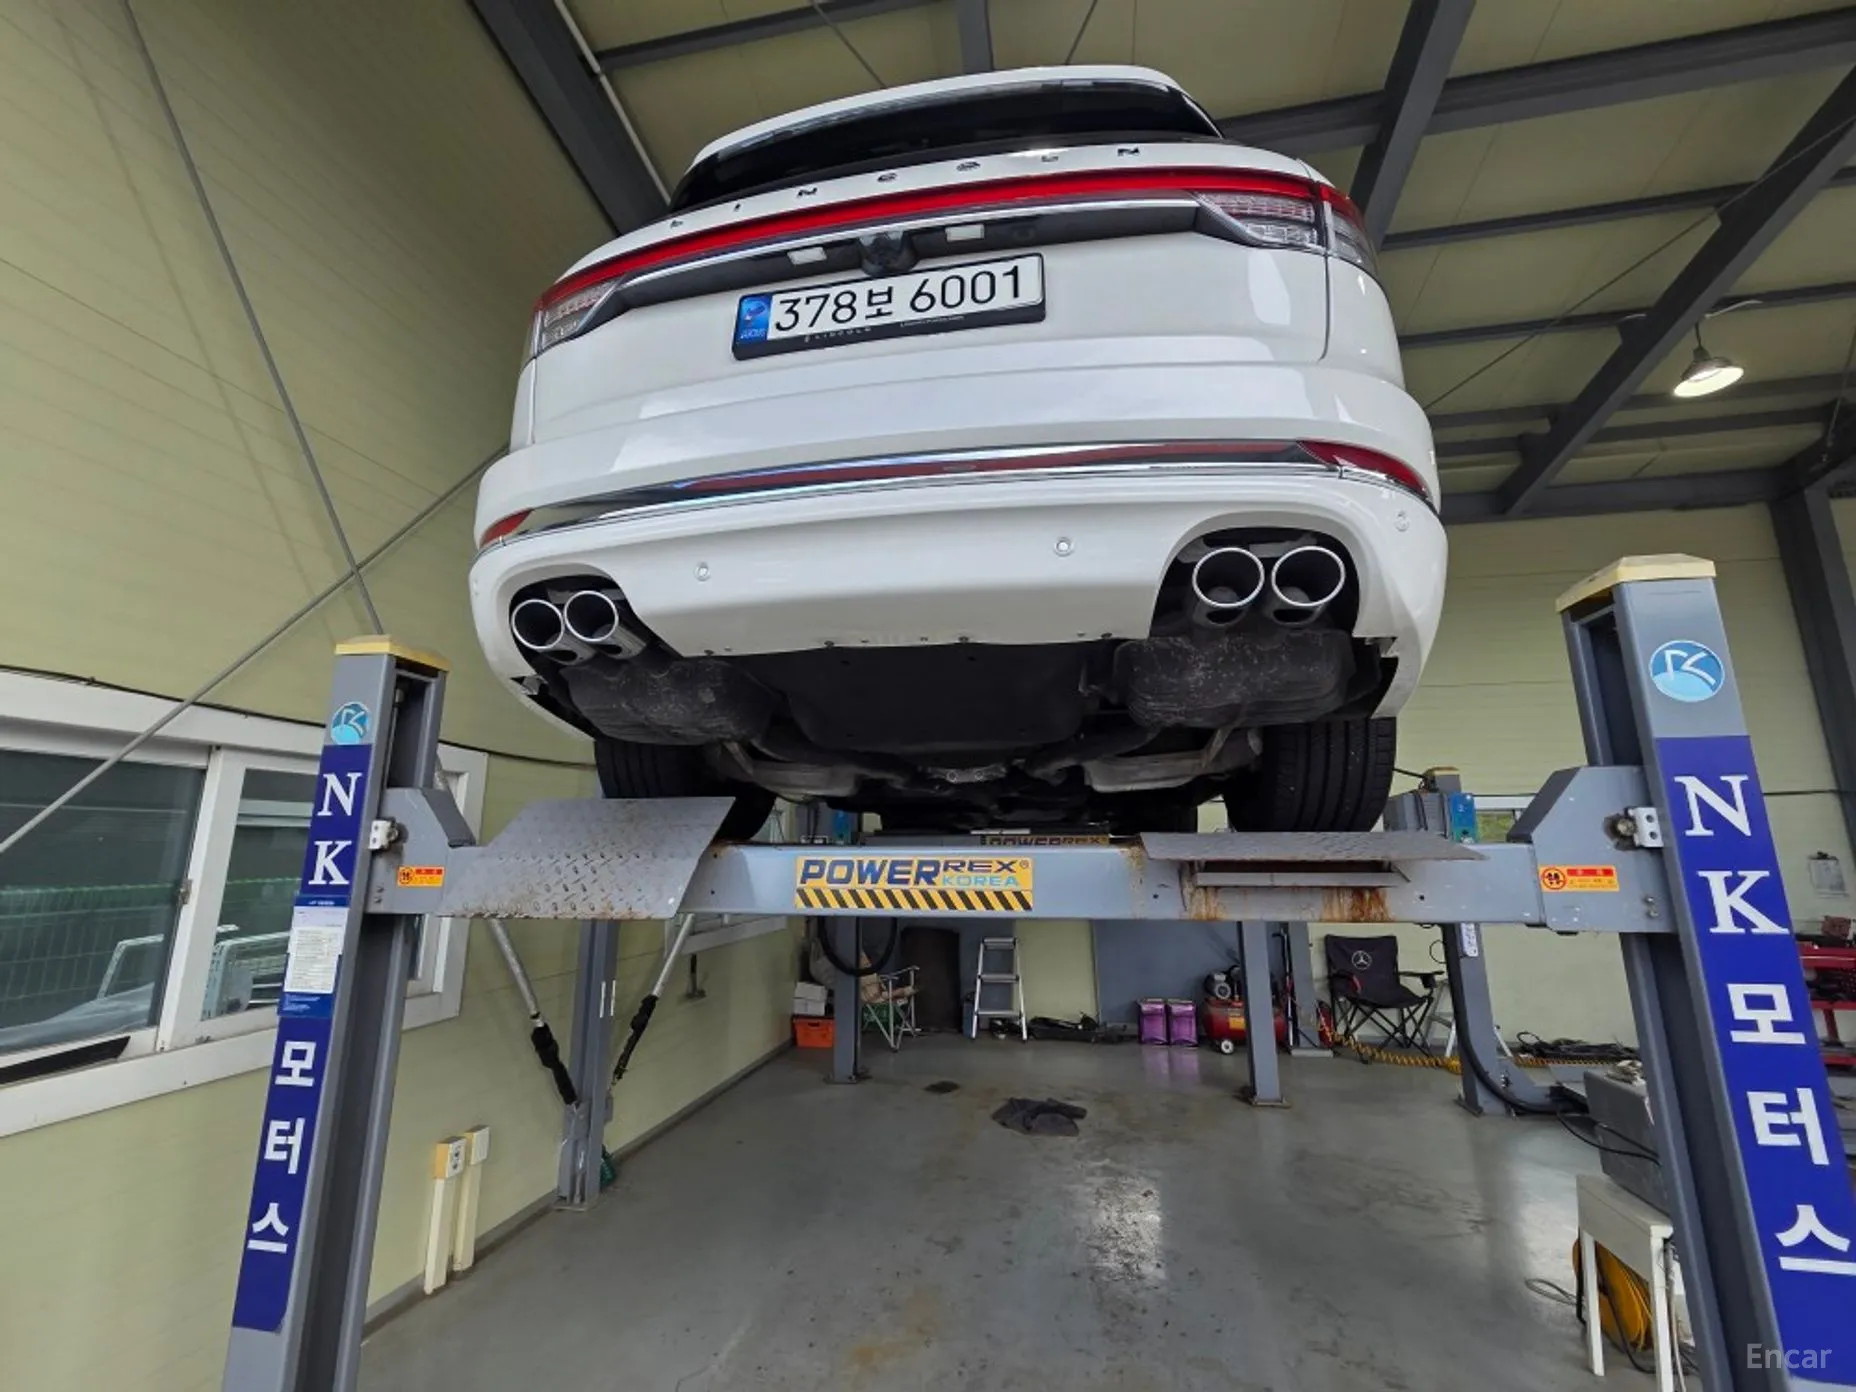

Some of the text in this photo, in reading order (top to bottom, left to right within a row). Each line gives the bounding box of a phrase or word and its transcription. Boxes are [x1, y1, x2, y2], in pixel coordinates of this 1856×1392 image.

[774, 264, 1021, 332] 378보 6001
[941, 875, 1020, 887] KOREA
